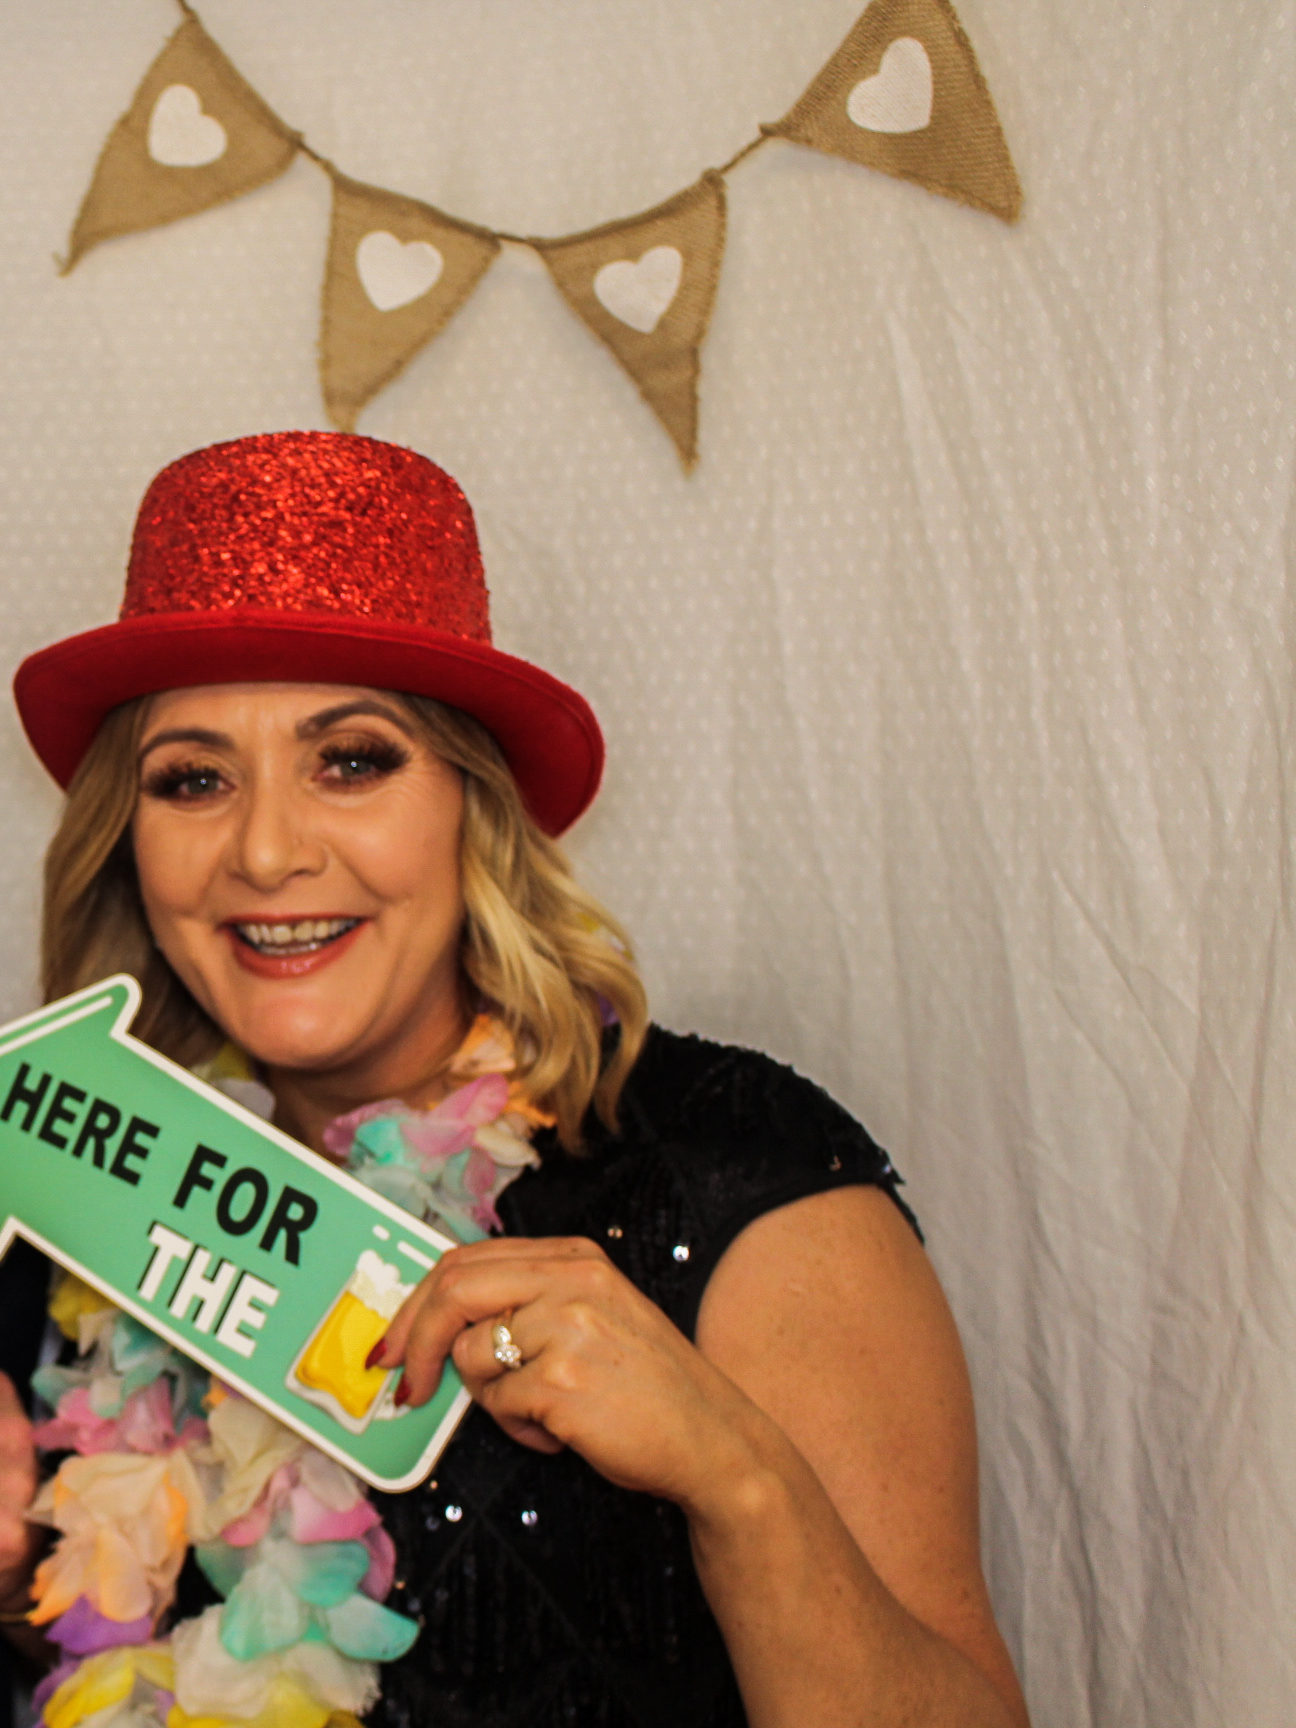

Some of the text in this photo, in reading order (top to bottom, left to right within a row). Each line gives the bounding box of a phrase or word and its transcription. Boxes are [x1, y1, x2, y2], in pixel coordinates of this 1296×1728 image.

[0, 1062, 319, 1266] HERE FOR
[137, 1221, 280, 1359] THE
